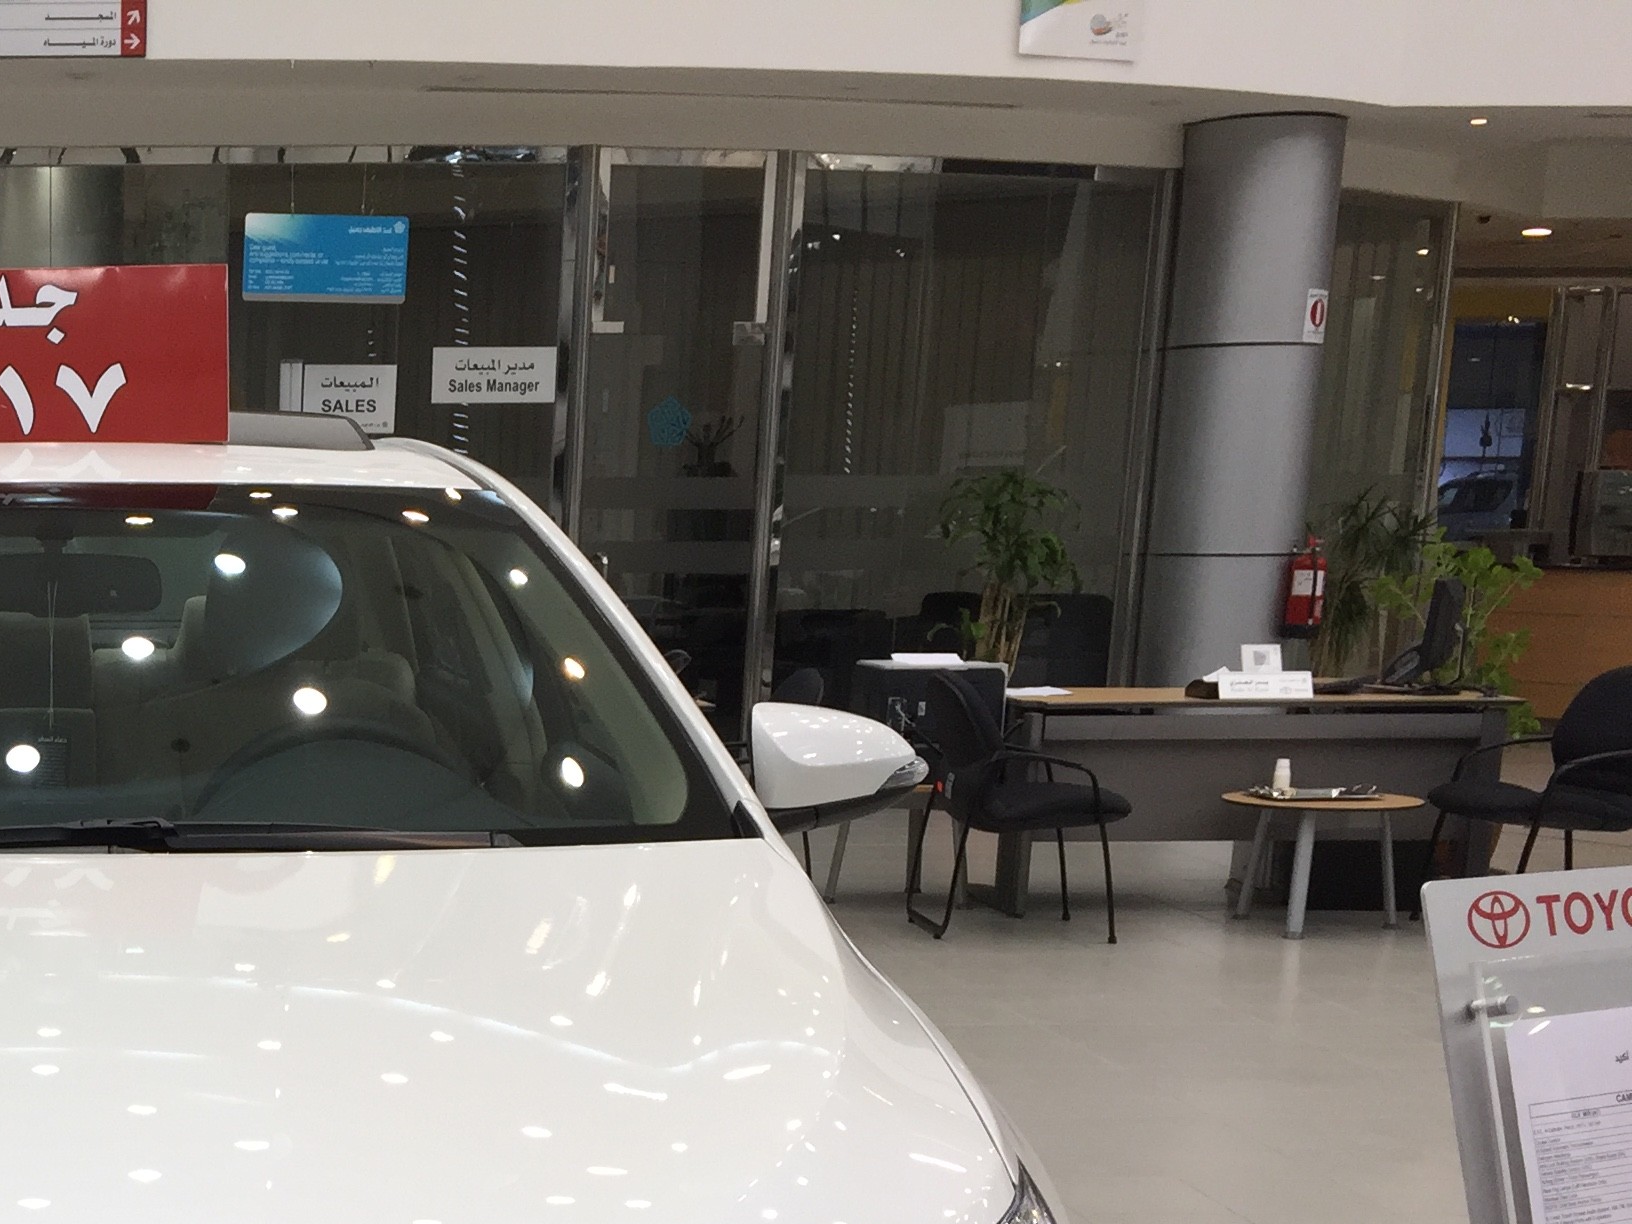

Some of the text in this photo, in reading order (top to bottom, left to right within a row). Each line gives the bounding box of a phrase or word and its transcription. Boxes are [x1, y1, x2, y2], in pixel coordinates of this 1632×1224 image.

[100, 35, 116, 49] دورة
[455, 360, 535, 376] مدير المبيعات
[320, 376, 379, 392] المبيعات
[448, 379, 540, 395] Sales Manager
[321, 399, 377, 413] SALES
